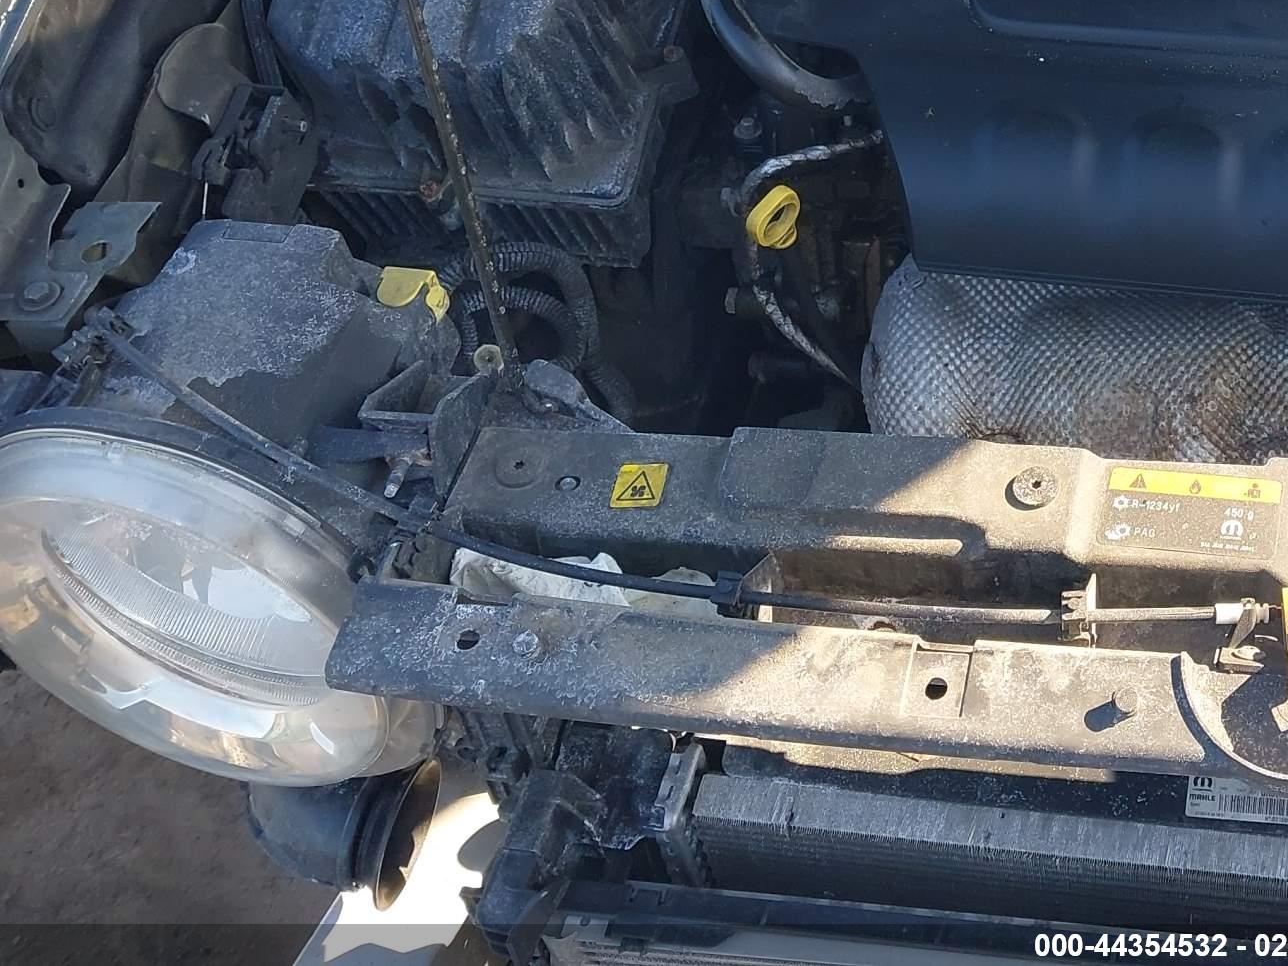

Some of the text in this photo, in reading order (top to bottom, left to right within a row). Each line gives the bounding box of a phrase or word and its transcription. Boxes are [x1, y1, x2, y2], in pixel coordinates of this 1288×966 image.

[1131, 498, 1181, 514] R-1234yf
[1224, 507, 1244, 519] 450
[1133, 527, 1157, 538] PAG
[1189, 793, 1216, 802] MAHLE
